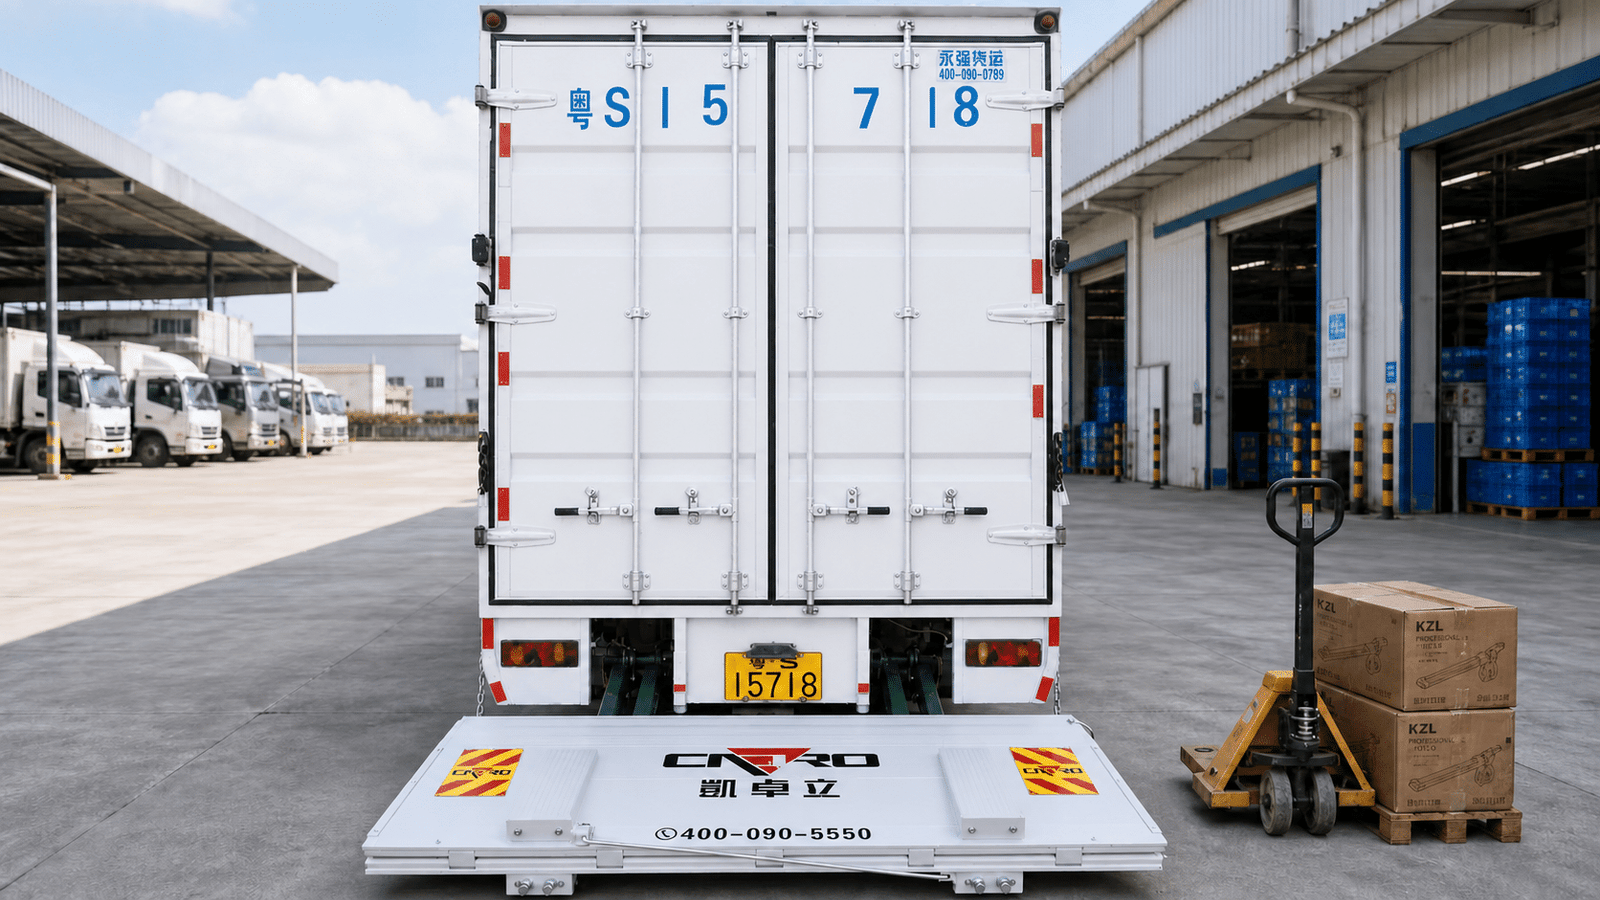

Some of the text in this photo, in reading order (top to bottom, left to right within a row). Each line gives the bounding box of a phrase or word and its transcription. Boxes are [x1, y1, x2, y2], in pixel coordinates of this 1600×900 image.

[939, 68, 1004, 80] 400-090-0789
[1317, 598, 1336, 613] KZL
[1416, 620, 1444, 632] KZL
[736, 671, 817, 698] 15718
[1408, 723, 1437, 735] KZL
[699, 779, 840, 798] 凱卓立
[680, 827, 872, 840] 400-090-5550
